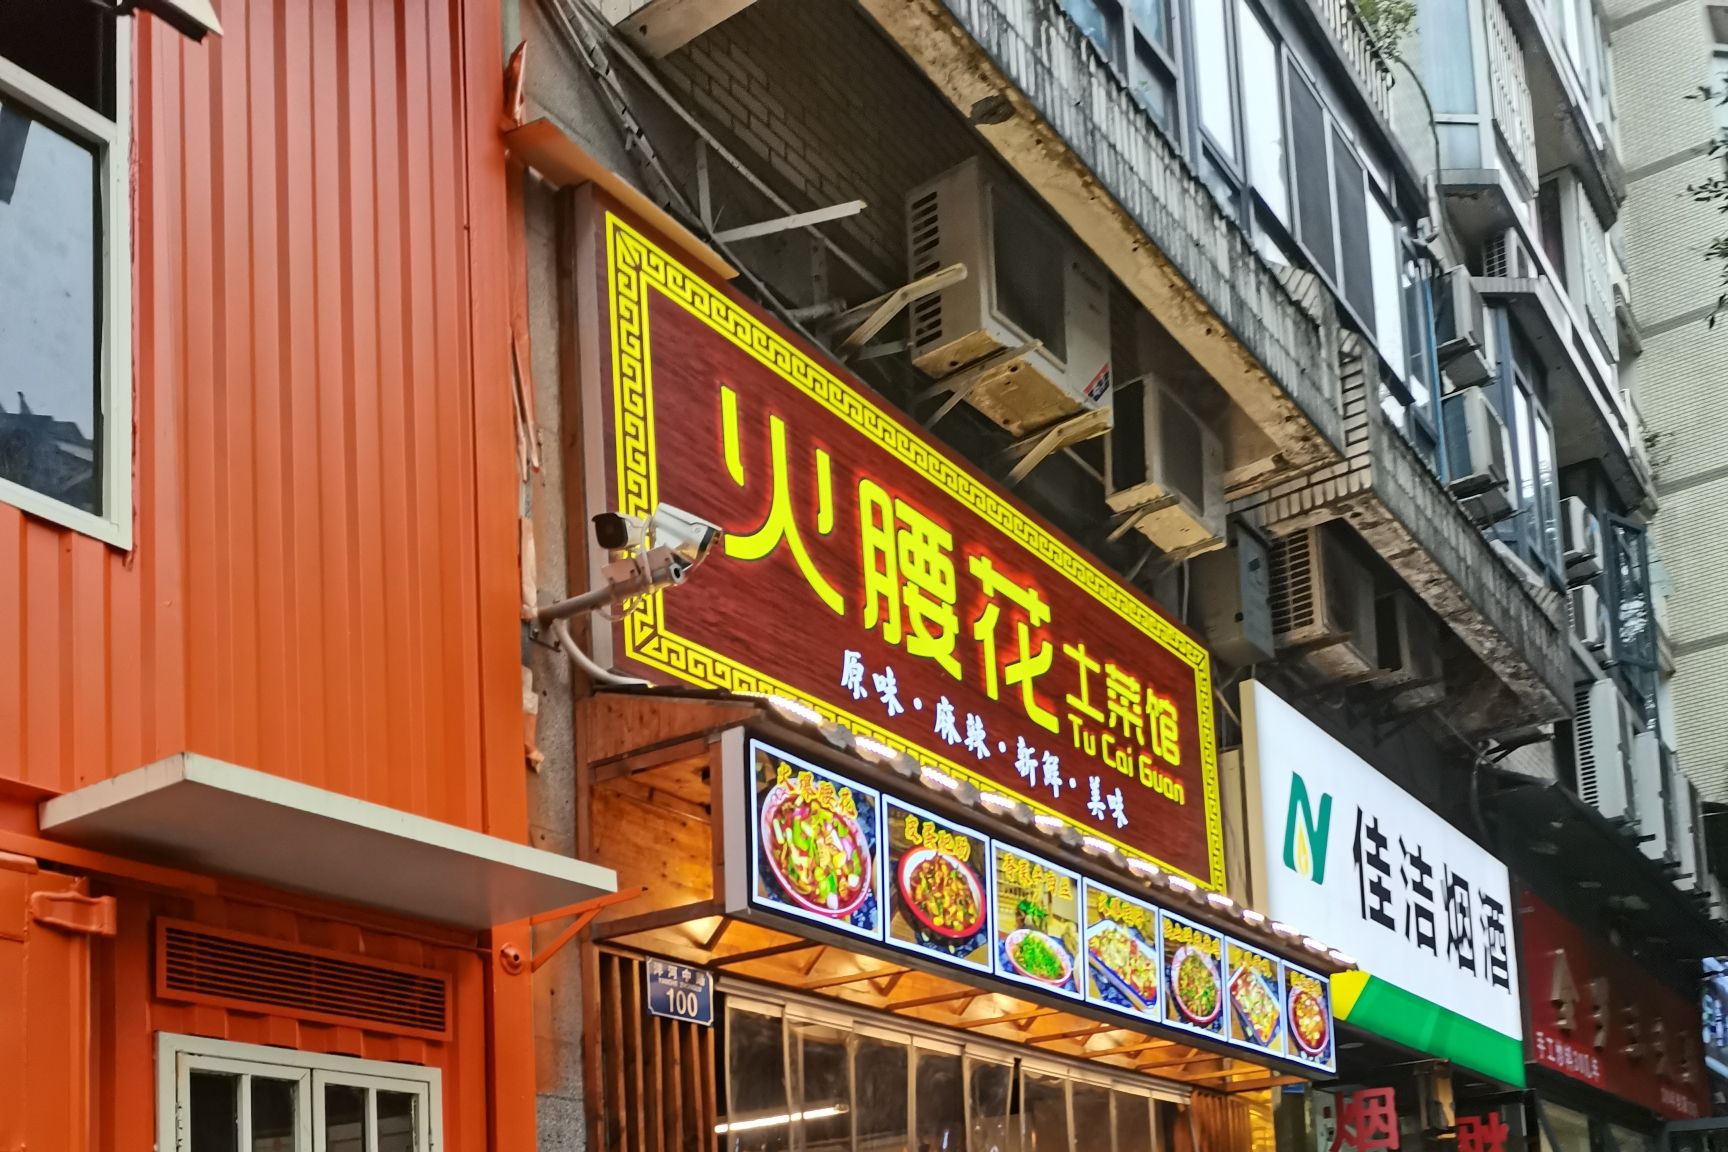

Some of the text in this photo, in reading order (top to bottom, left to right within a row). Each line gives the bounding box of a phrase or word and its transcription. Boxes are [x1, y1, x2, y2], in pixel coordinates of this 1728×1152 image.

[721, 385, 1180, 766] 火腰花 土菜馆
[1068, 713, 1185, 805] Tu Cai Guan
[1353, 804, 1511, 995] 佳洁烟酒
[666, 987, 698, 1018] 100
